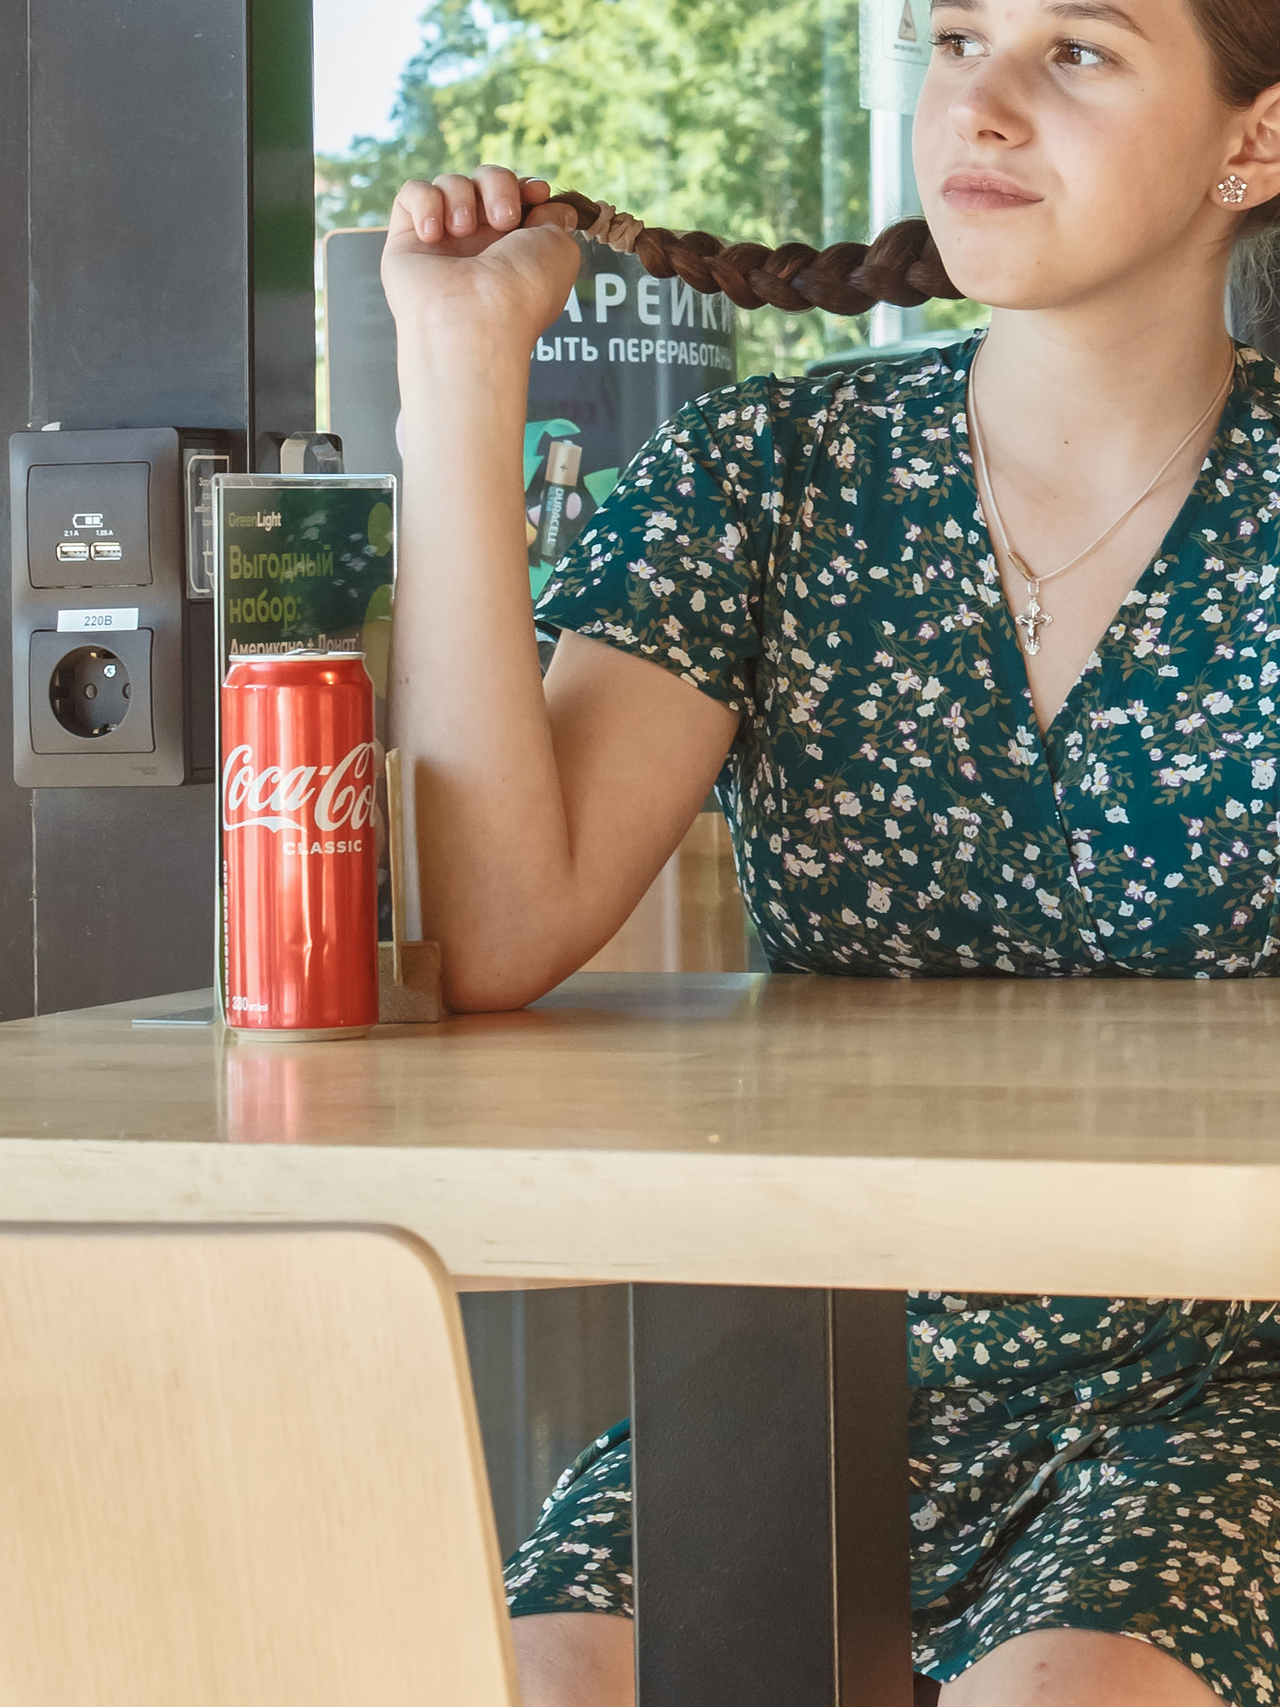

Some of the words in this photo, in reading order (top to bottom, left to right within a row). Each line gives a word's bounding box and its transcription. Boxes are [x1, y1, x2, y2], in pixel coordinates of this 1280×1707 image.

[532, 336, 599, 362] ЫТЬ
[547, 487, 565, 544] DURACELL
[229, 544, 334, 584] Выгодный
[282, 839, 362, 856] CLASSIC
